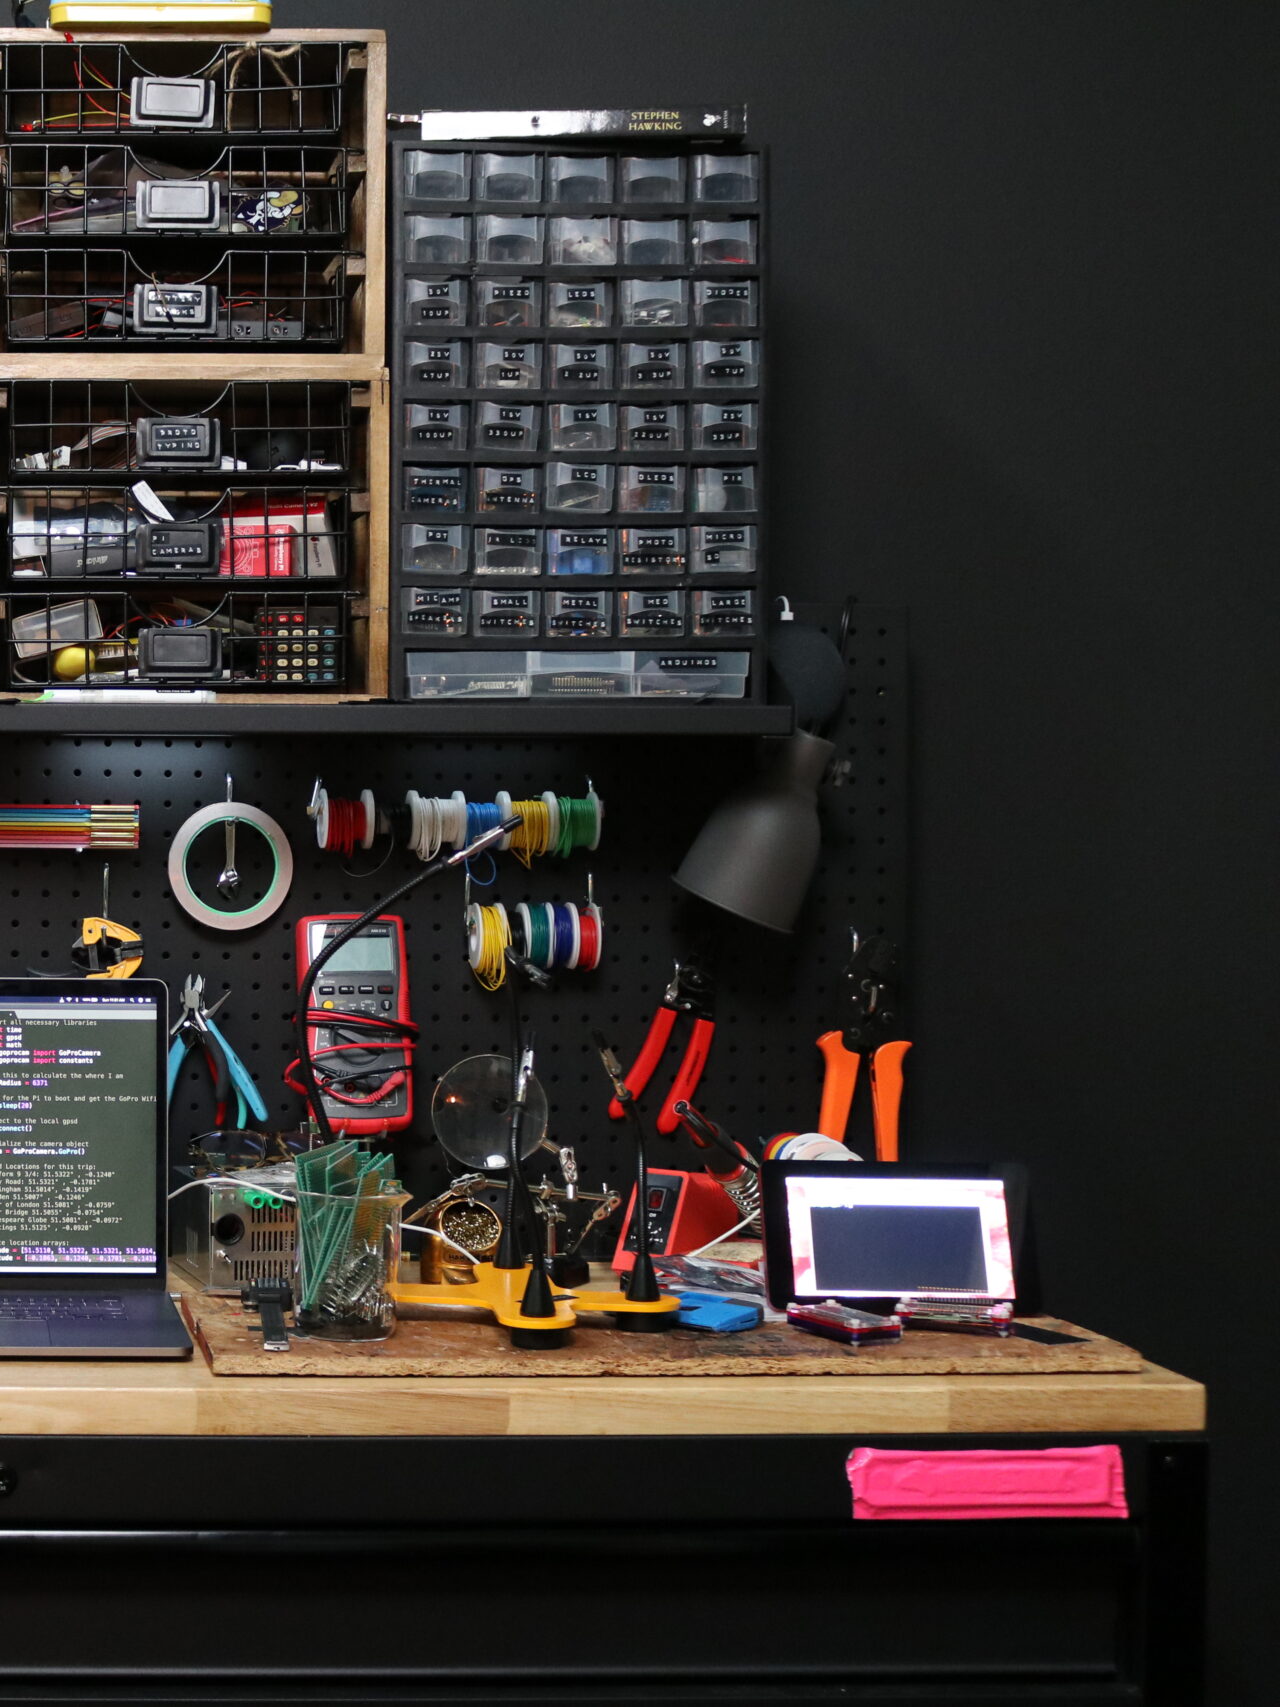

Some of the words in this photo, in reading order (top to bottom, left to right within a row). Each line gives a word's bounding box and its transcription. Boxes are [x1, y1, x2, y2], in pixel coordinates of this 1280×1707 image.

[630, 111, 680, 121] STEPHEN
[628, 121, 683, 132] HAWKING
[152, 547, 202, 555] CAMERAS
[660, 659, 717, 667] ARDUINOS
